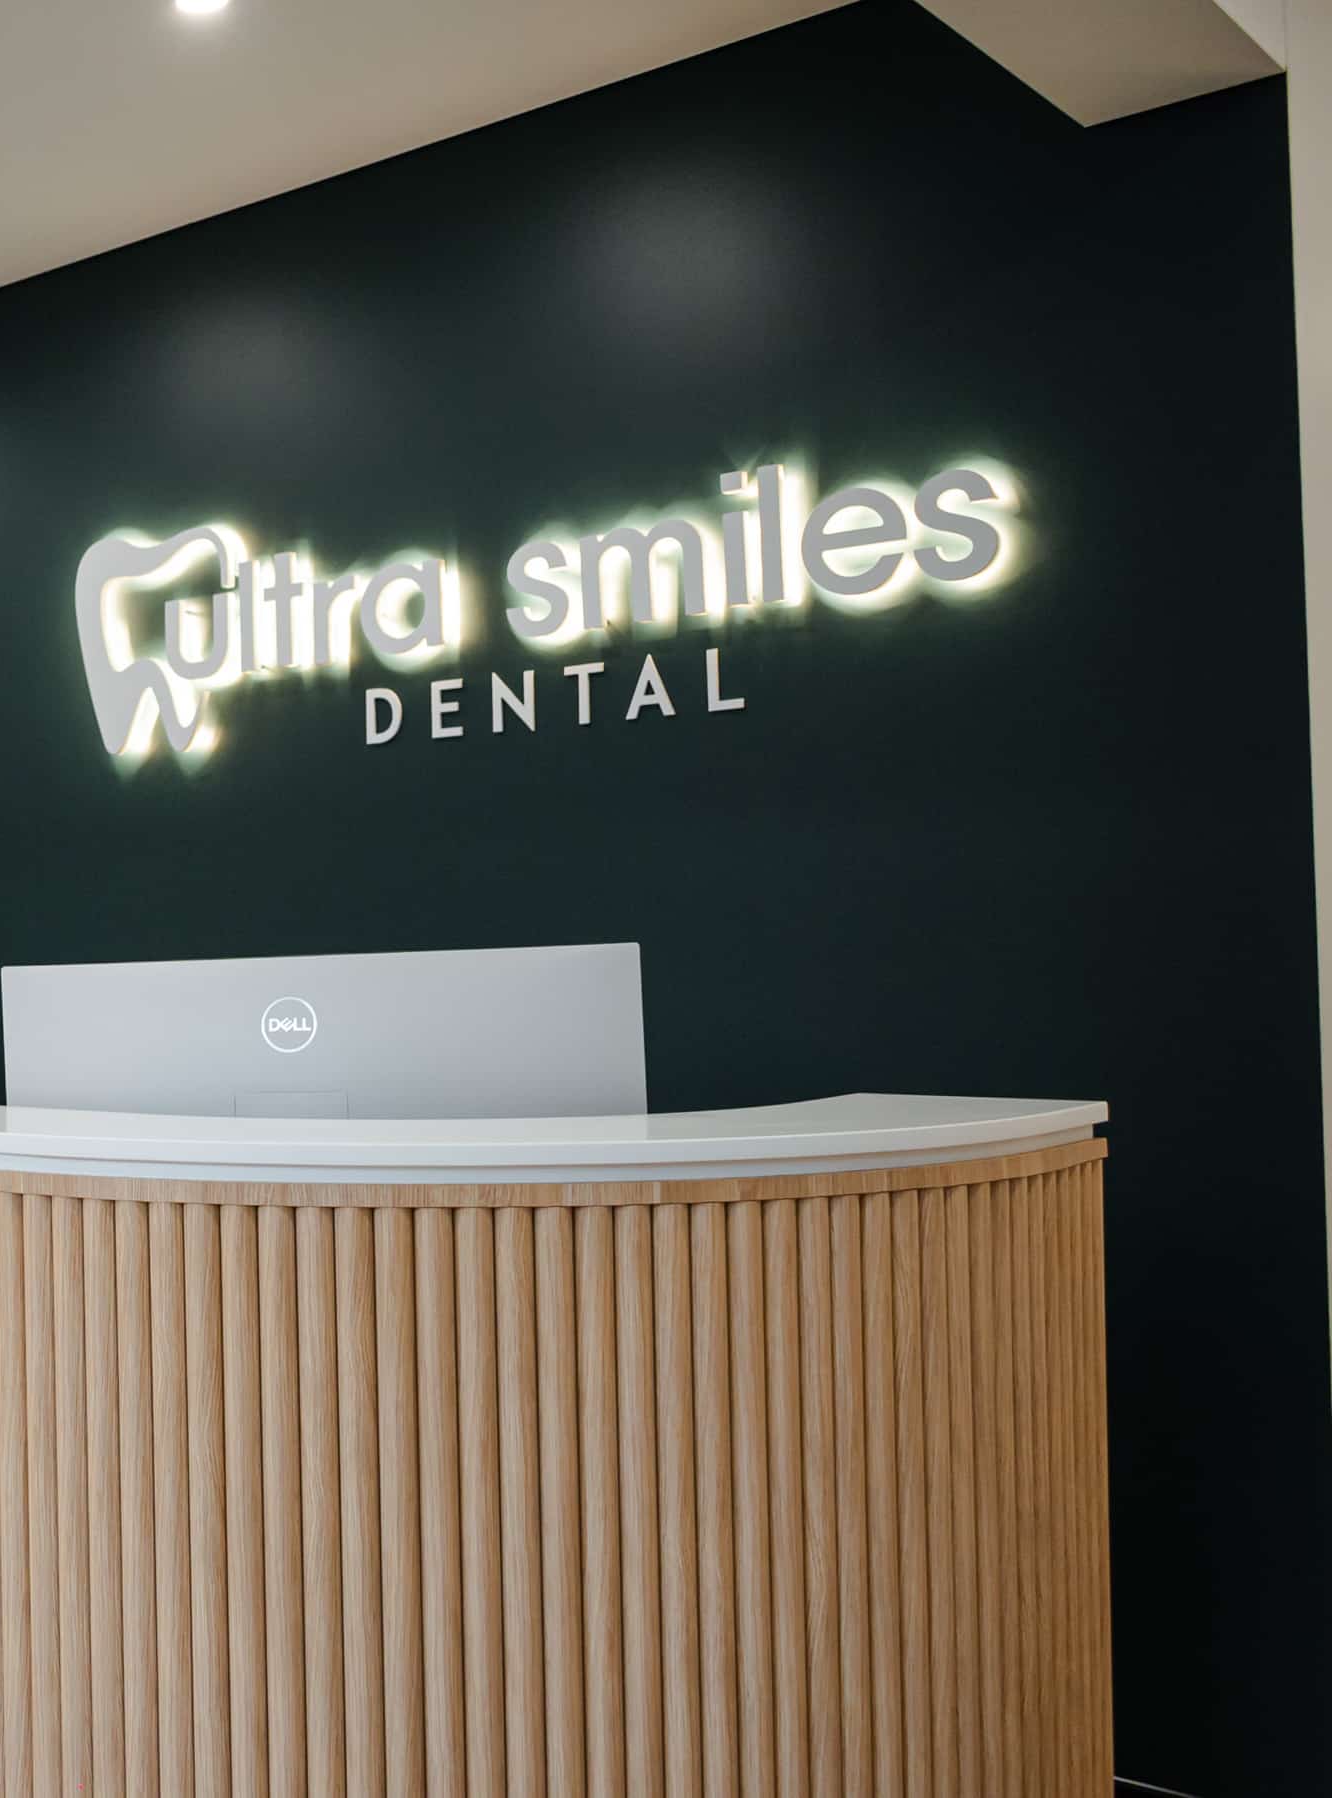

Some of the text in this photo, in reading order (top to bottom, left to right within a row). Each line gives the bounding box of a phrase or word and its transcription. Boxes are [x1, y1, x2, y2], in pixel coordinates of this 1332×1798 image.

[164, 463, 1000, 680] ultra smiles
[365, 647, 746, 745] DENTAL
[268, 1016, 312, 1033] DELL
